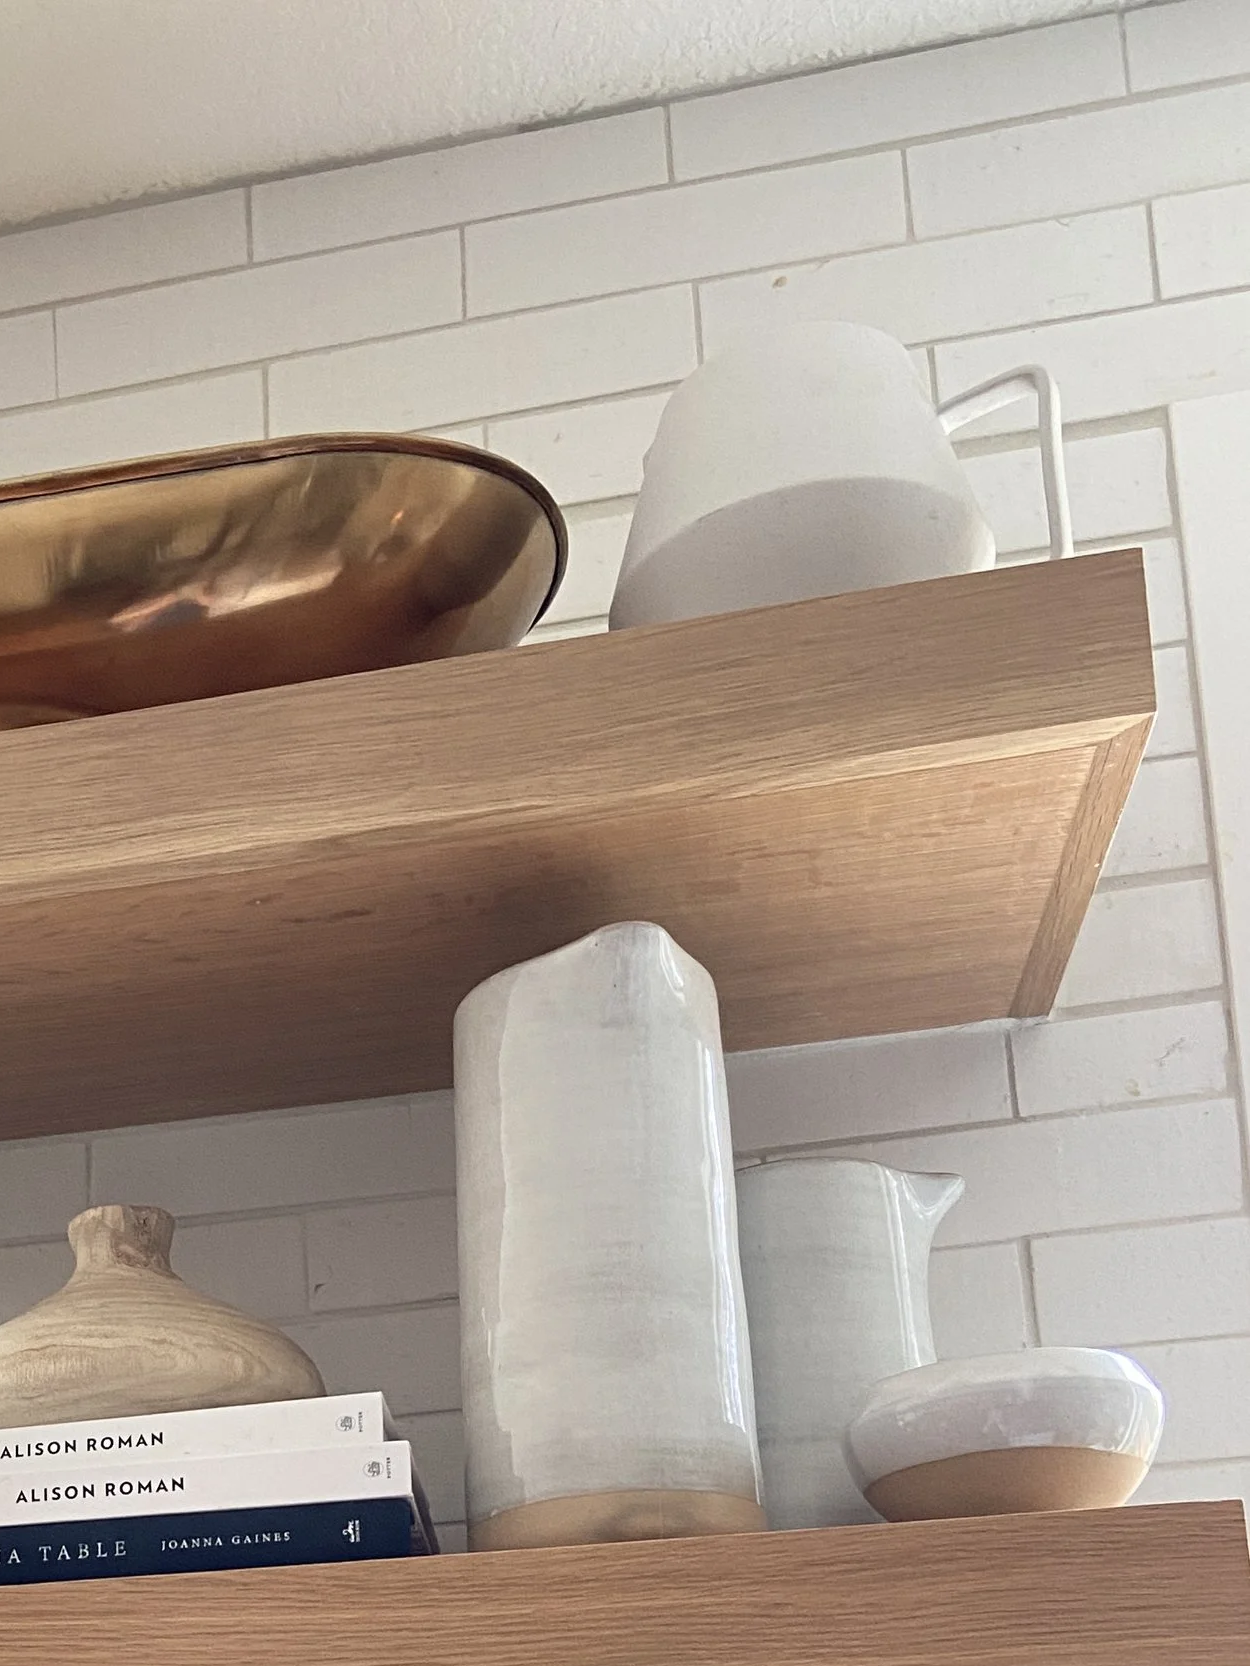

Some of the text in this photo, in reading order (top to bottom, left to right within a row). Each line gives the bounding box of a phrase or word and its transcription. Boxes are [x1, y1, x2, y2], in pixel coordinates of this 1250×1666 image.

[0, 1439, 77, 1459] ALISON
[87, 1432, 164, 1451] ROMAN
[15, 1484, 95, 1504] ALISON
[105, 1477, 185, 1497] ROMAN
[38, 1541, 127, 1561] TABLE
[161, 1537, 223, 1551] JOANNA
[231, 1531, 291, 1545] GAINES
